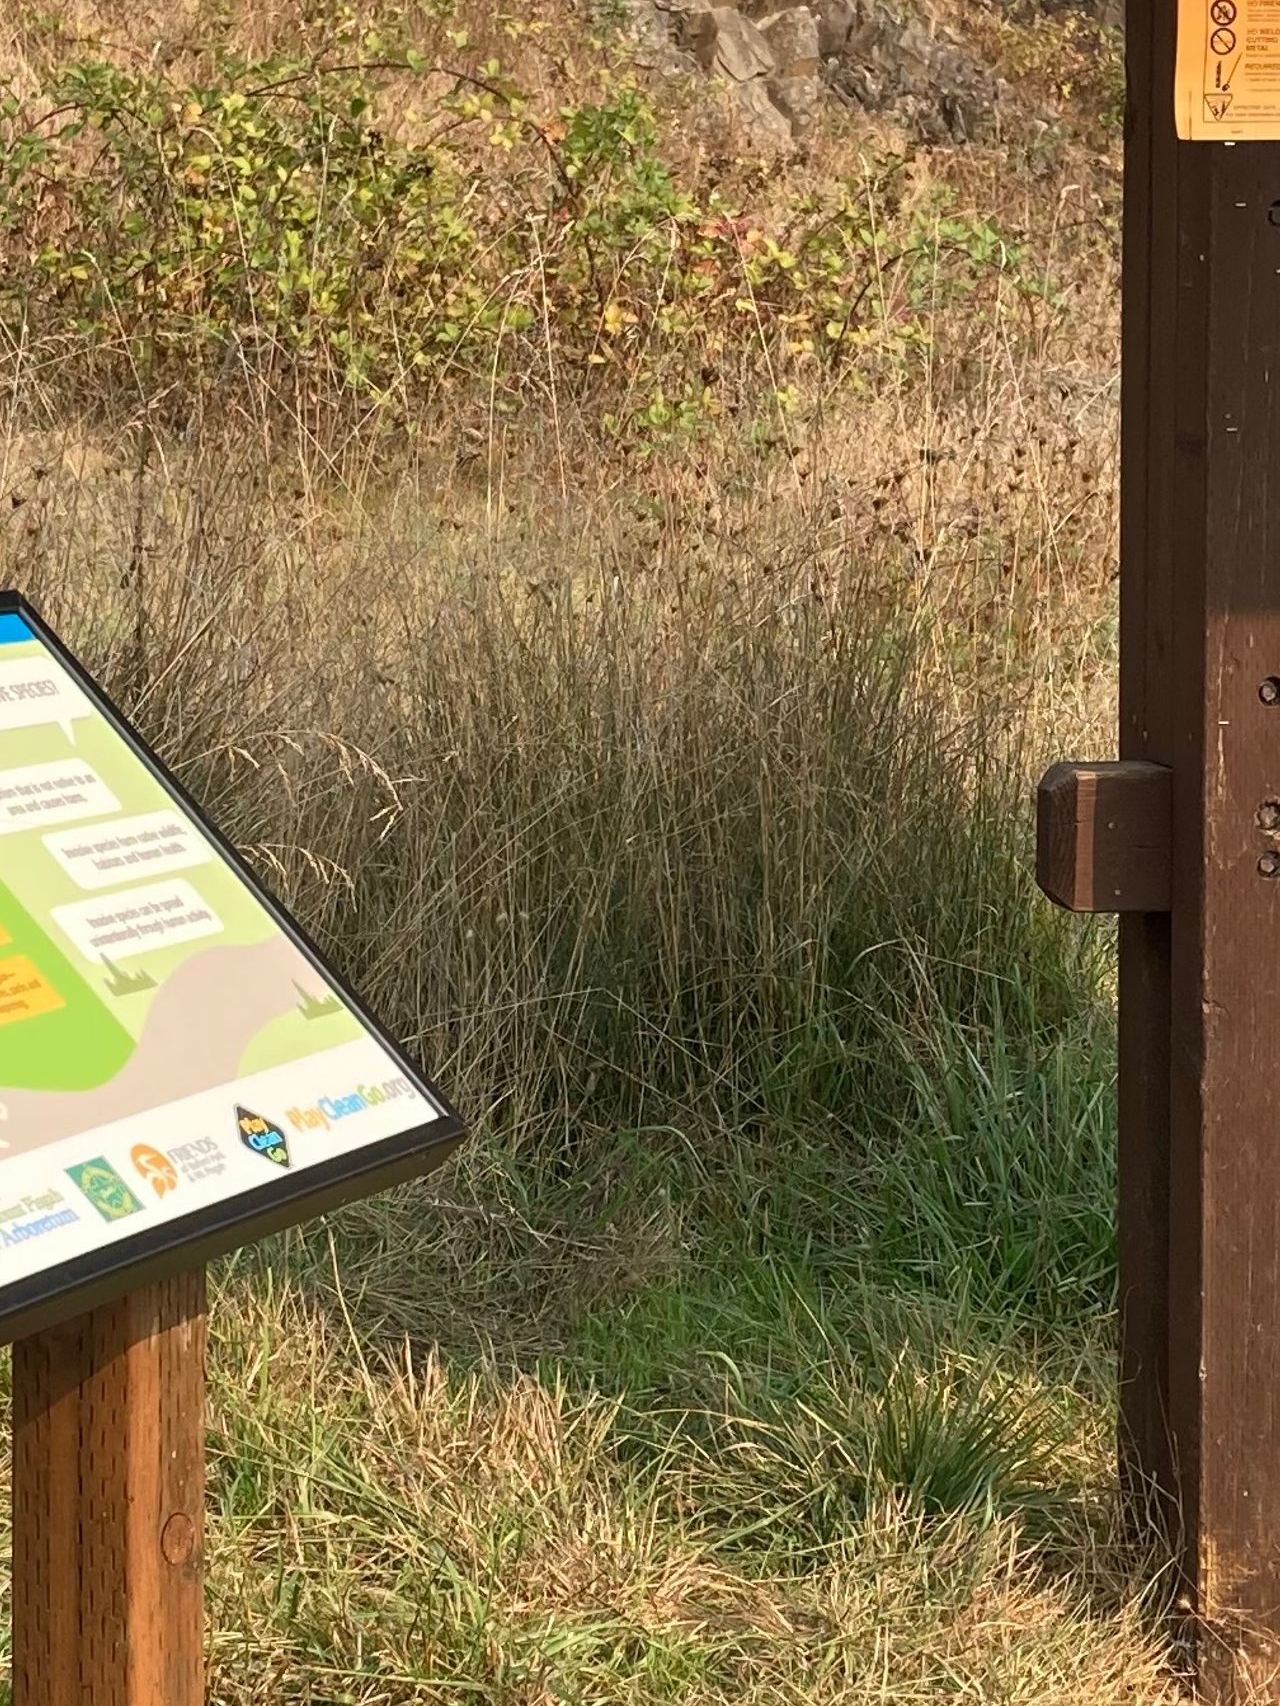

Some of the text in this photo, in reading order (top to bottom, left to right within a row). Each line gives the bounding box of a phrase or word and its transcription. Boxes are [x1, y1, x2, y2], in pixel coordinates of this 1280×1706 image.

[8, 678, 59, 700] SPECIES?
[285, 1076, 415, 1133] PlayCleanGo.org
[239, 1116, 269, 1136] Play
[167, 1136, 219, 1165] FRIENDS
[248, 1131, 283, 1150] Clean
[266, 1146, 287, 1163] Go
[22, 1188, 65, 1212] Pisgah
